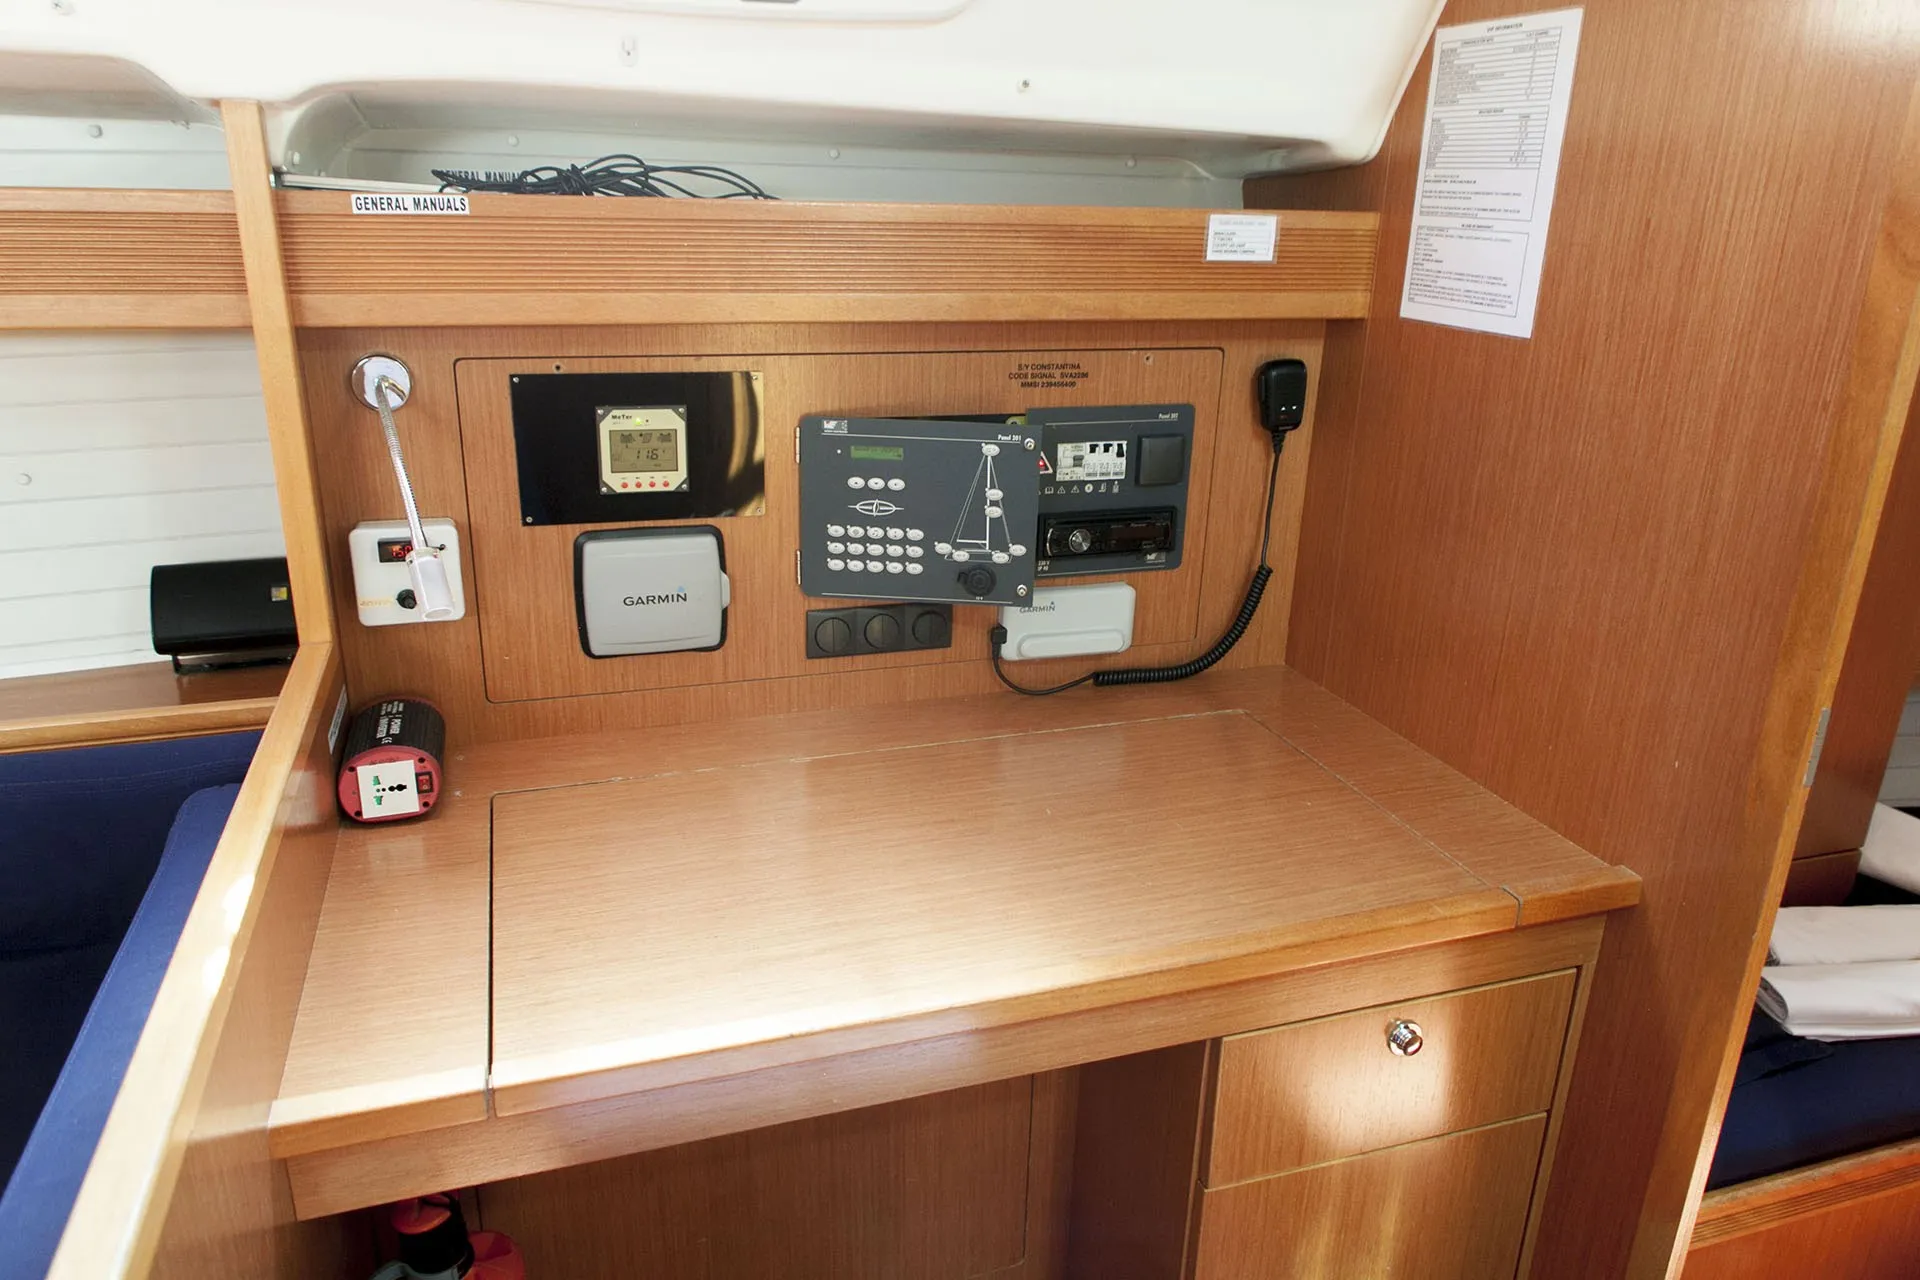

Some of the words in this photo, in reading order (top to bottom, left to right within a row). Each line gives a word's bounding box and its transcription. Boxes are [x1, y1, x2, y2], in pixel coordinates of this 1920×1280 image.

[440, 168, 480, 183] ENERAL
[355, 196, 409, 211] GENERAL
[412, 197, 467, 212] MANUALS
[1031, 363, 1081, 371] CONSTANTINA
[1008, 372, 1029, 380] CODE
[1030, 371, 1057, 380] SIGNAL
[622, 592, 688, 607] GARMIN
[1019, 604, 1056, 614] GARMIN
